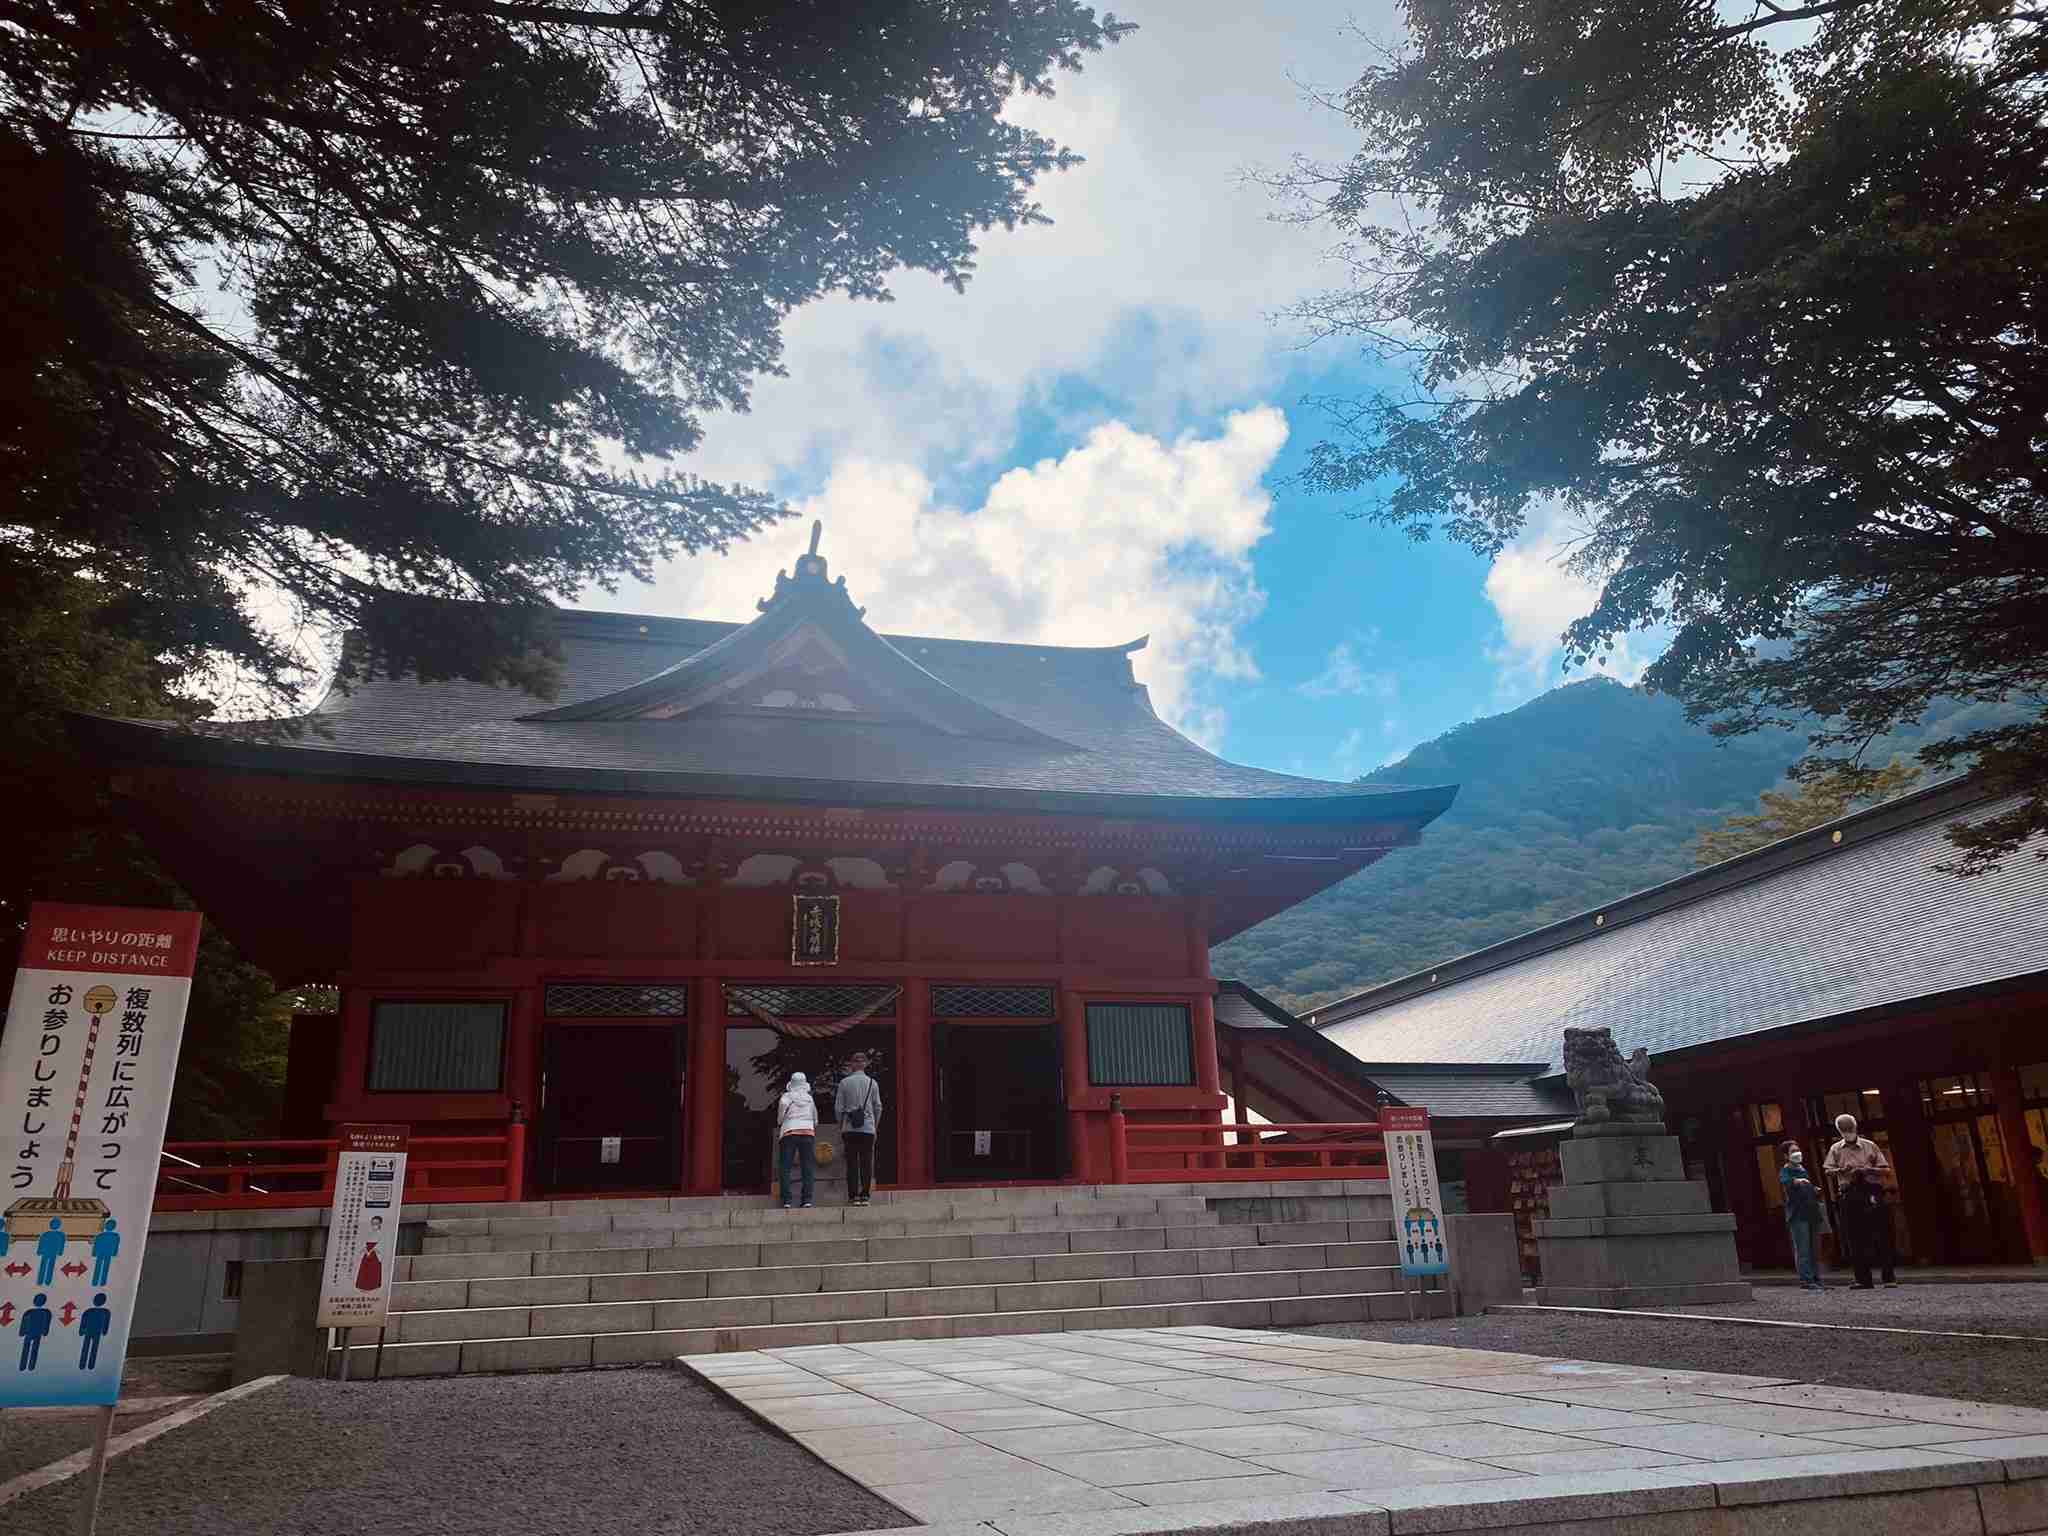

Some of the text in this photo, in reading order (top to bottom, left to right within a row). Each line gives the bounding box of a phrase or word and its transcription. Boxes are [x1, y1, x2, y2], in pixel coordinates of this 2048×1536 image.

[47, 949, 169, 968] KEEP DISTANCE
[51, 927, 173, 949] 思いやりの距離
[10, 984, 73, 1189] お参りしましょう
[93, 986, 152, 1190] 複数列に広がって
